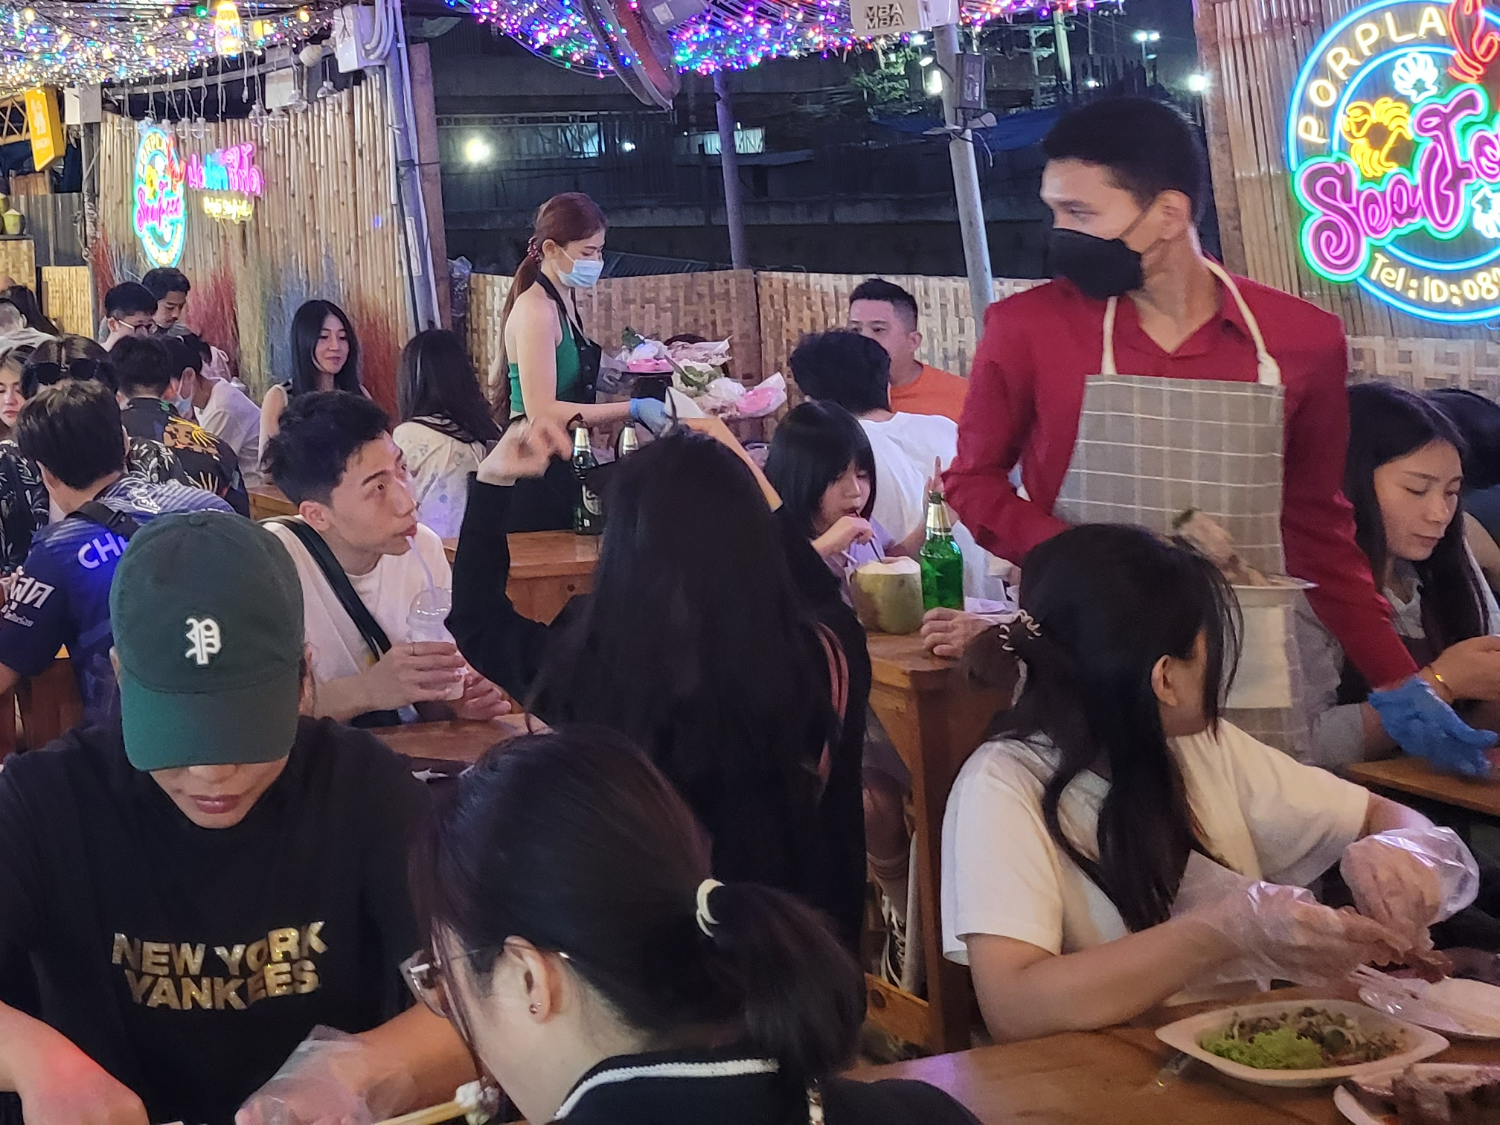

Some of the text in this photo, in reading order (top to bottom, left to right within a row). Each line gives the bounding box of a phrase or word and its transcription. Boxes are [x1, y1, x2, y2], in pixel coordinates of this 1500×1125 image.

[865, 2, 904, 18] MBA
[866, 15, 905, 29] MBA
[1298, 7, 1448, 144] PORPLA
[111, 920, 329, 976] NEW YORK
[124, 959, 321, 1010] YANKEES
